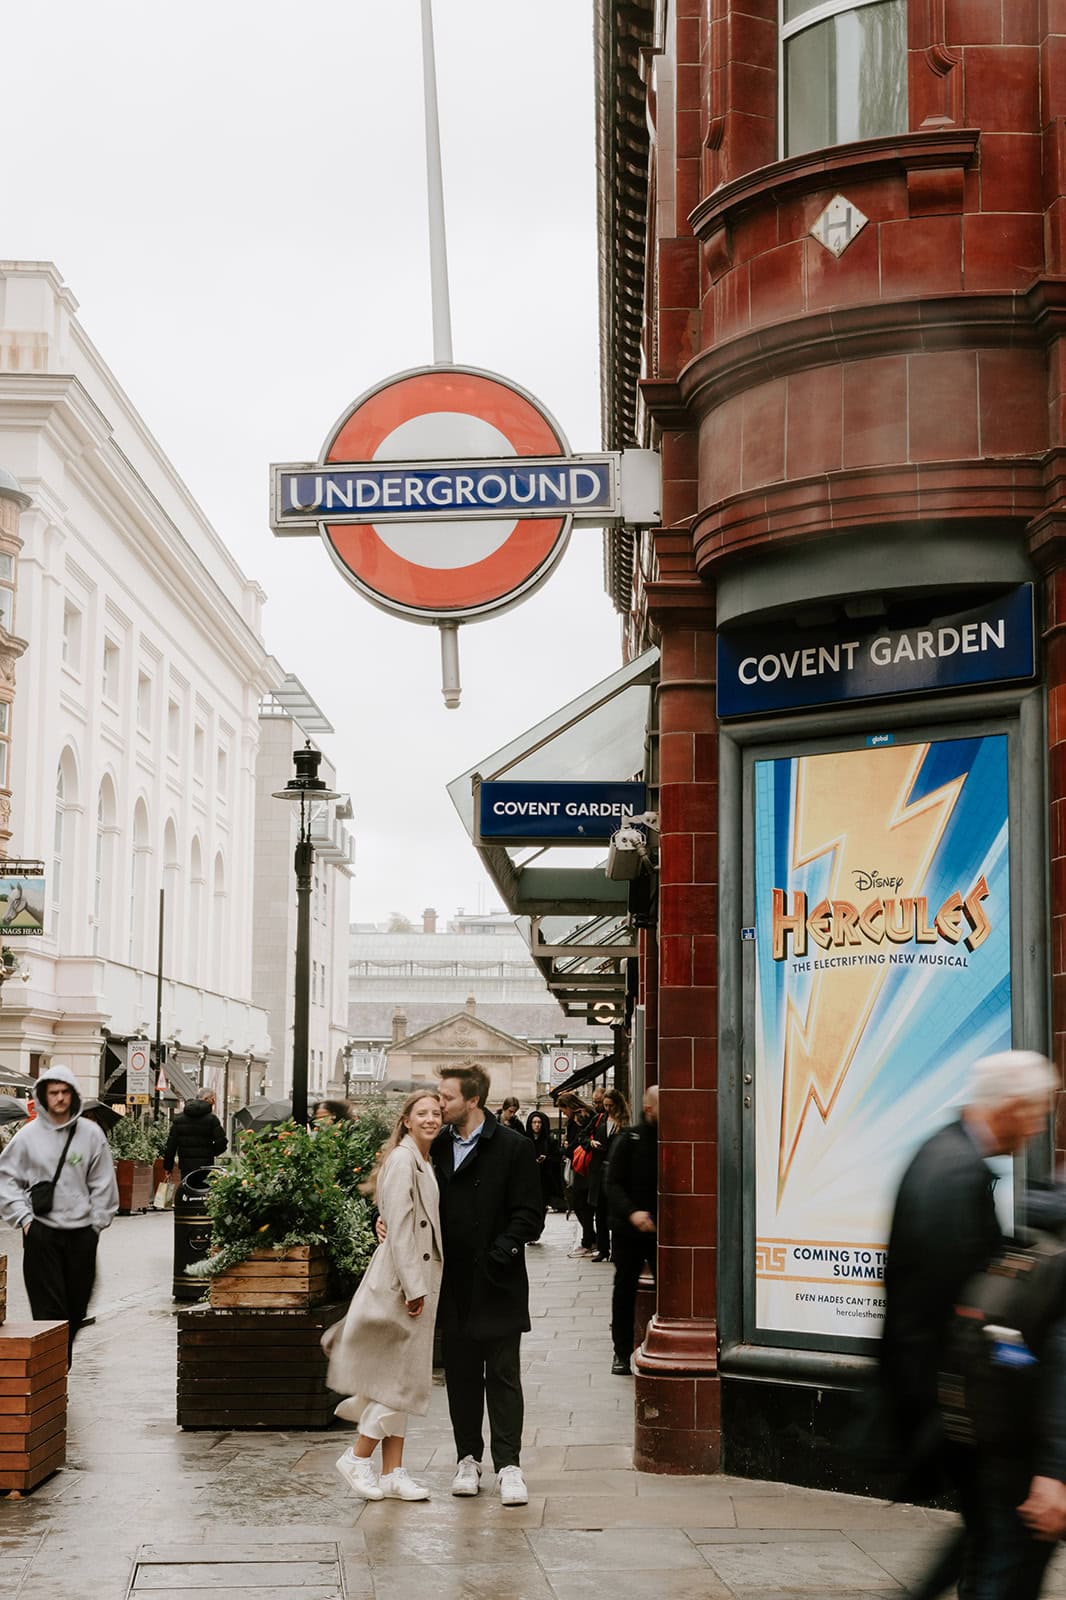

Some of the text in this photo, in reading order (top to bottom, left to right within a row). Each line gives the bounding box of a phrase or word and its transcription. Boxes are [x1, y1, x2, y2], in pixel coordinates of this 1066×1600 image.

[823, 207, 852, 244] H
[290, 469, 600, 511] UNDERGROUND
[738, 619, 1005, 685] COVENT GARDEN
[493, 802, 633, 816] COVENT GARDEN
[771, 874, 992, 962] HERCULES
[2, 927, 22, 935] NAGS
[22, 927, 43, 935] HEAD
[792, 954, 968, 973] THE ELECTRIFYING NEW MUSICAL
[793, 1248, 849, 1262] COMING
[854, 1251, 871, 1264] TO
[795, 1293, 816, 1302] EVEN
[818, 1295, 844, 1304] HADES
[845, 1297, 871, 1306] CAN'T
